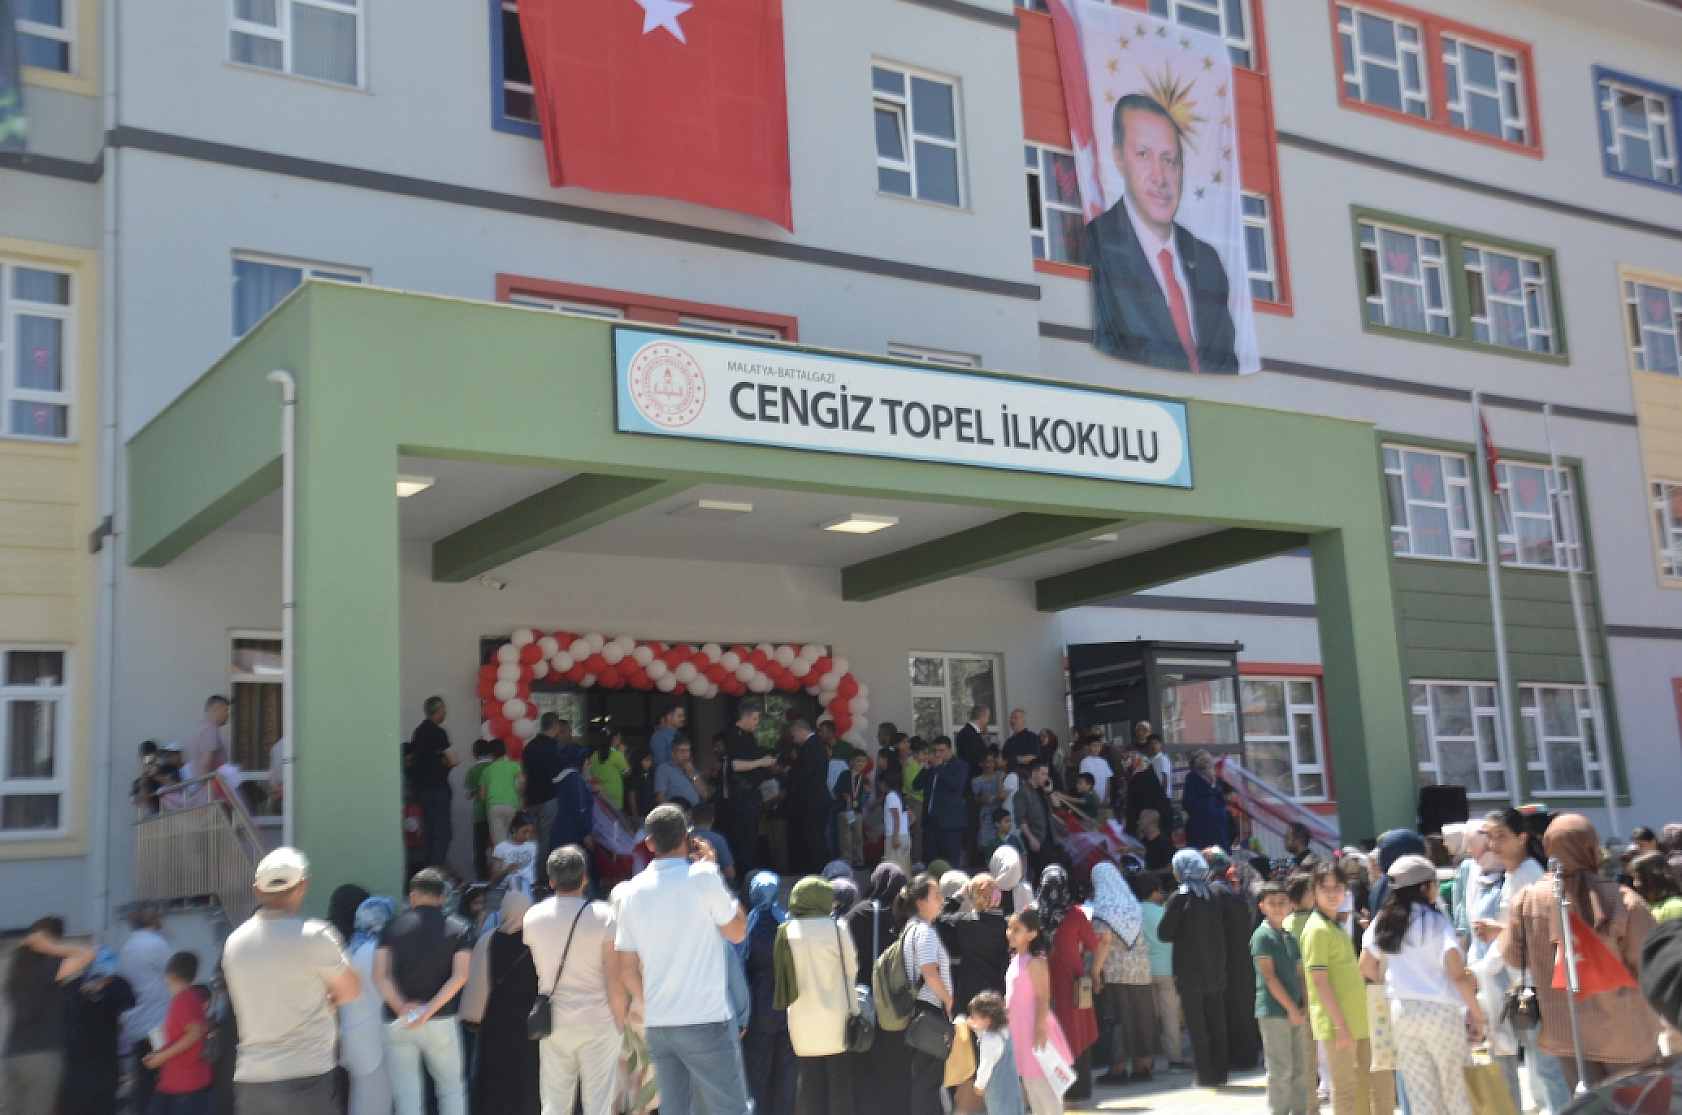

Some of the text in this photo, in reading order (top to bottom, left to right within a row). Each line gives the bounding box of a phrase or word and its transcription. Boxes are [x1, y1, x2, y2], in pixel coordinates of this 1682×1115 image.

[730, 381, 875, 433] CENGİZ
[879, 397, 995, 445] TOPEL
[1001, 403, 1159, 464] İLKOKULU
